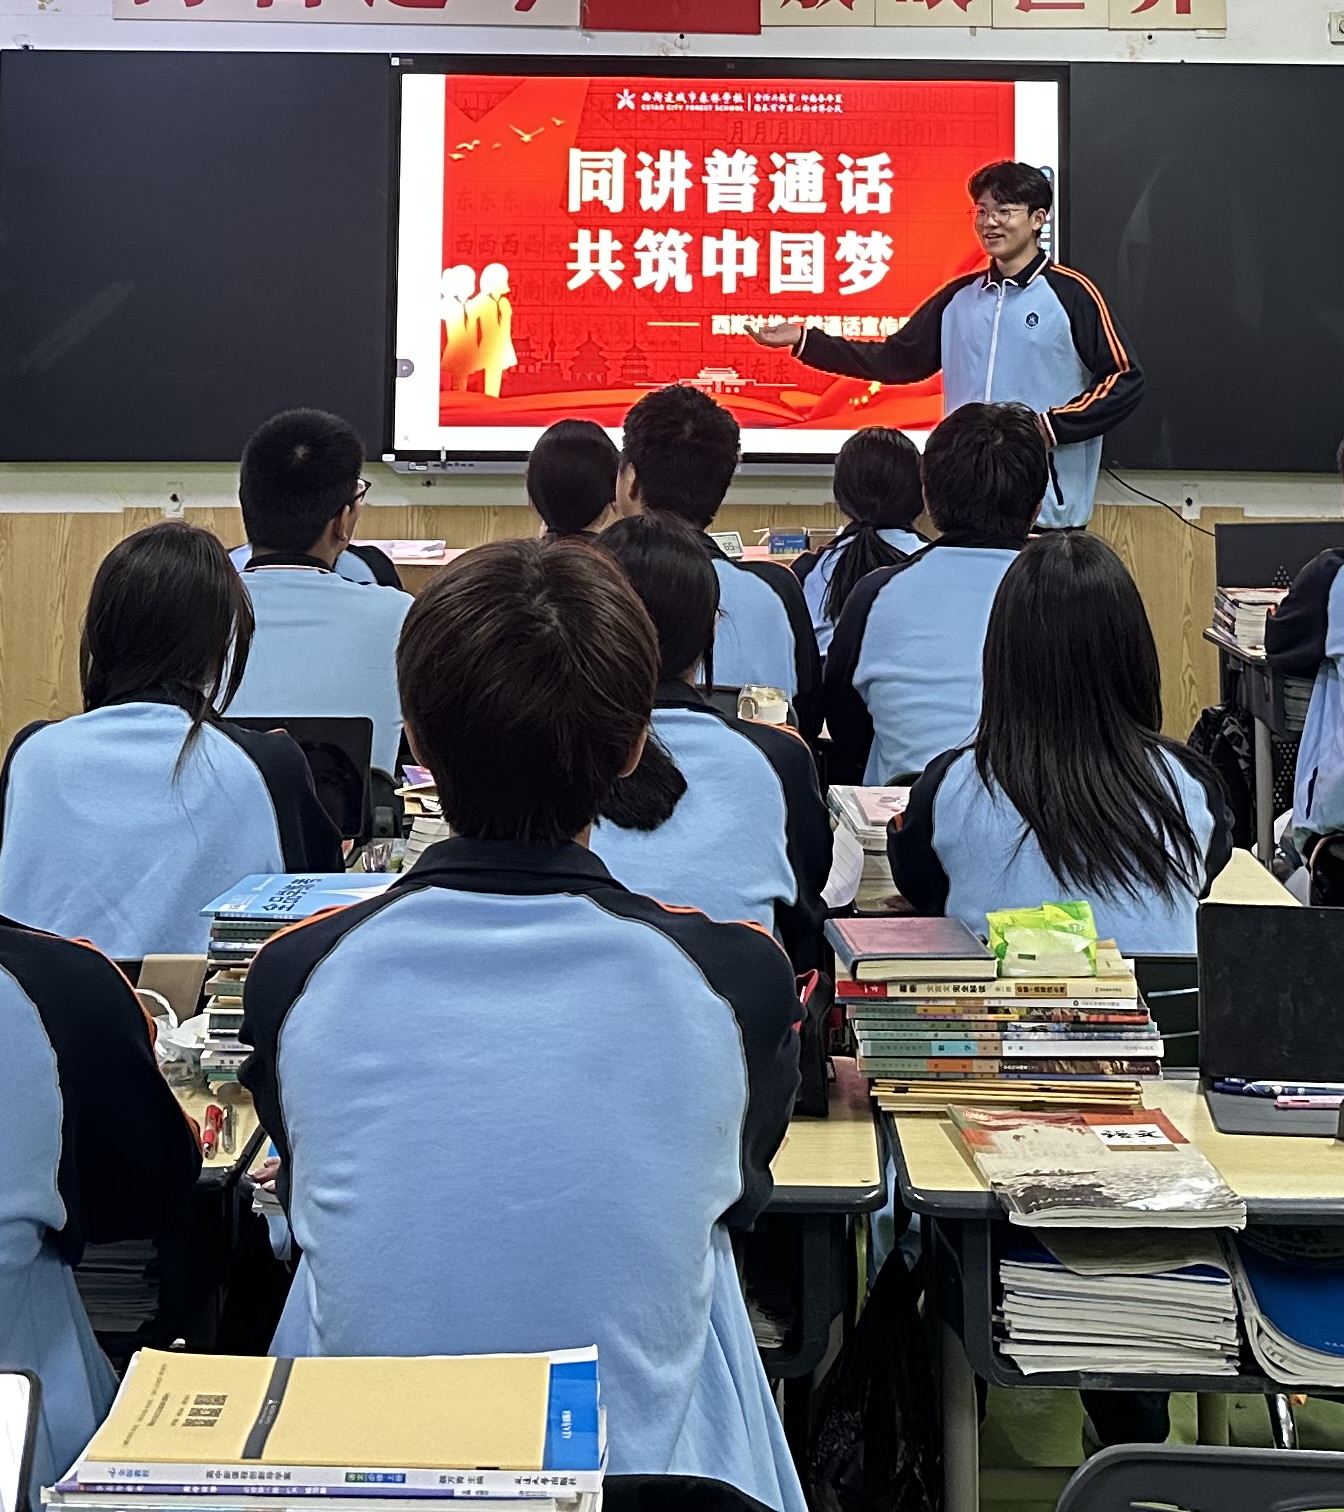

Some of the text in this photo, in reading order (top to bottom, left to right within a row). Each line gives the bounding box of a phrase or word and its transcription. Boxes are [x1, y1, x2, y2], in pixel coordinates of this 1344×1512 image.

[714, 103, 744, 112] SCHOOL
[568, 147, 894, 215] 同讲普通话
[567, 229, 894, 296] 共筑中国梦
